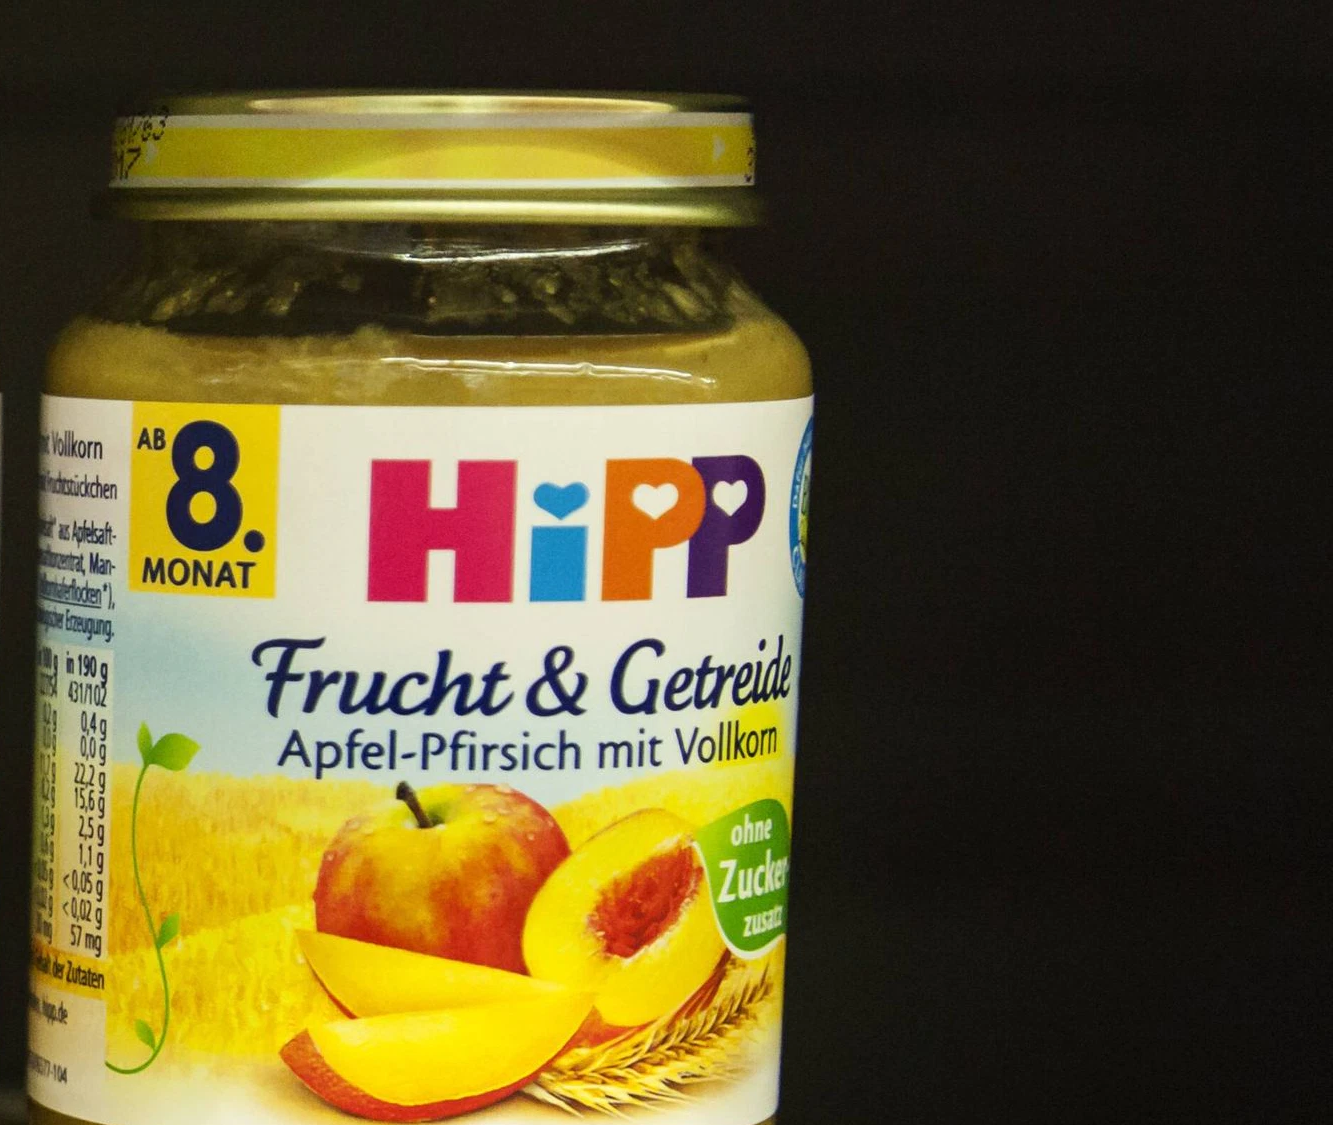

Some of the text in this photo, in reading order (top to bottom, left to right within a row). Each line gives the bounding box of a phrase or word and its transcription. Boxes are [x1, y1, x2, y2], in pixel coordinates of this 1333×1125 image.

[137, 427, 166, 453] AB
[165, 419, 266, 553] 8.
[366, 454, 766, 603] HiPP
[141, 556, 258, 590] MONAT
[250, 634, 793, 720] Frucht & Getreide
[277, 720, 778, 781] Apfel-Pfirsich mit Vollkorn
[730, 813, 773, 847] ohne
[742, 904, 783, 938] zusatz
